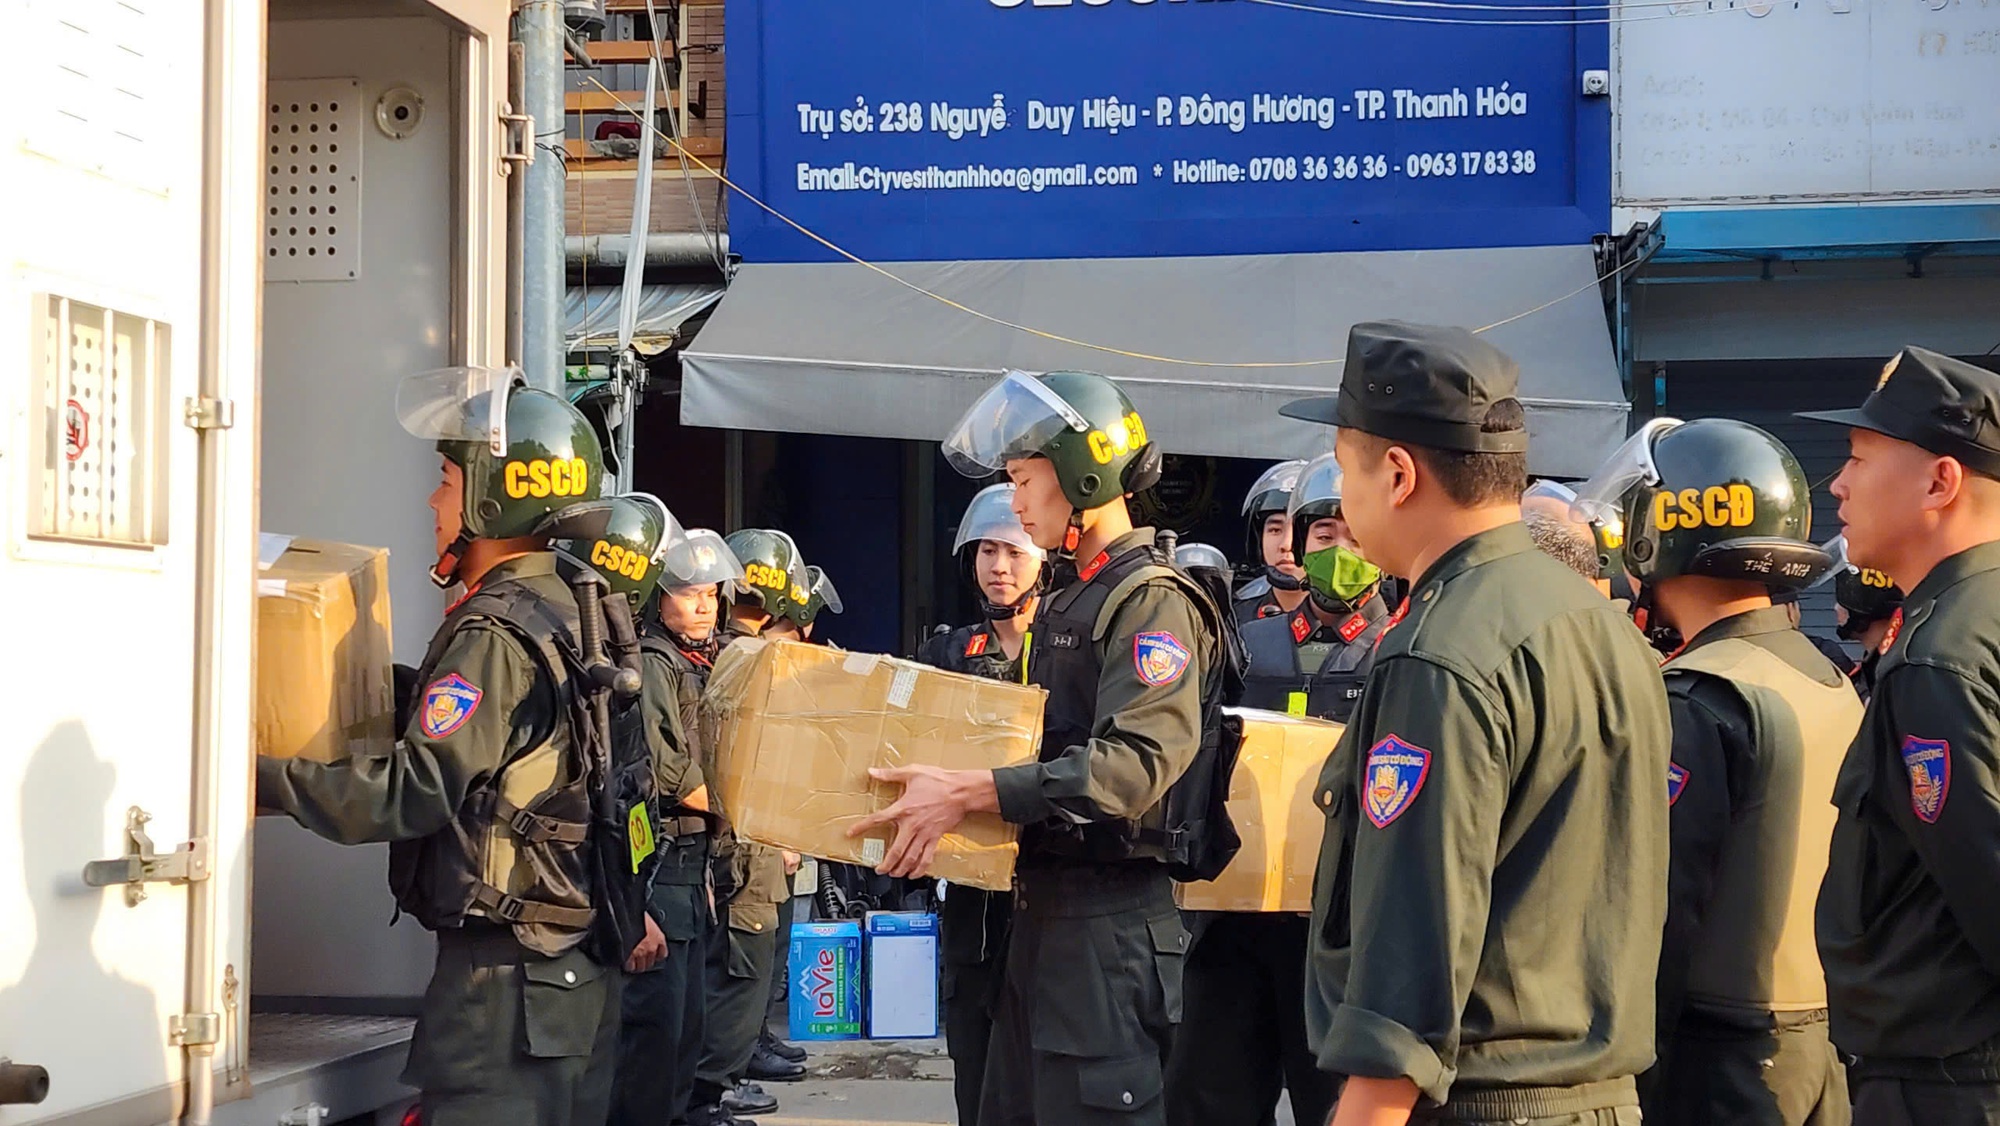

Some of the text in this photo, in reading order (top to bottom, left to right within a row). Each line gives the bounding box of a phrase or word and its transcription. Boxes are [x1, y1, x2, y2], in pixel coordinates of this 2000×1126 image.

[798, 103, 834, 140] Trụ
[839, 96, 874, 133] sở:
[879, 102, 923, 132] 238
[930, 93, 1017, 140] Nguyễ
[1028, 100, 1075, 135] Duy
[1083, 96, 1136, 134] Hiệu
[1157, 96, 1173, 126] P.
[1178, 93, 1246, 132] Đông
[1253, 93, 1334, 129] Hương
[1392, 87, 1468, 119] Thanh
[1476, 81, 1527, 116] Hóa
[1173, 159, 1246, 183] Hotline:
[1249, 156, 1297, 181] 0708
[1303, 156, 1328, 180] 36
[1333, 155, 1358, 179] 36
[1363, 155, 1387, 179] 36
[1406, 152, 1457, 178] 0963
[504, 456, 588, 498] CSCĐ
[1654, 484, 1754, 532] CSCĐ
